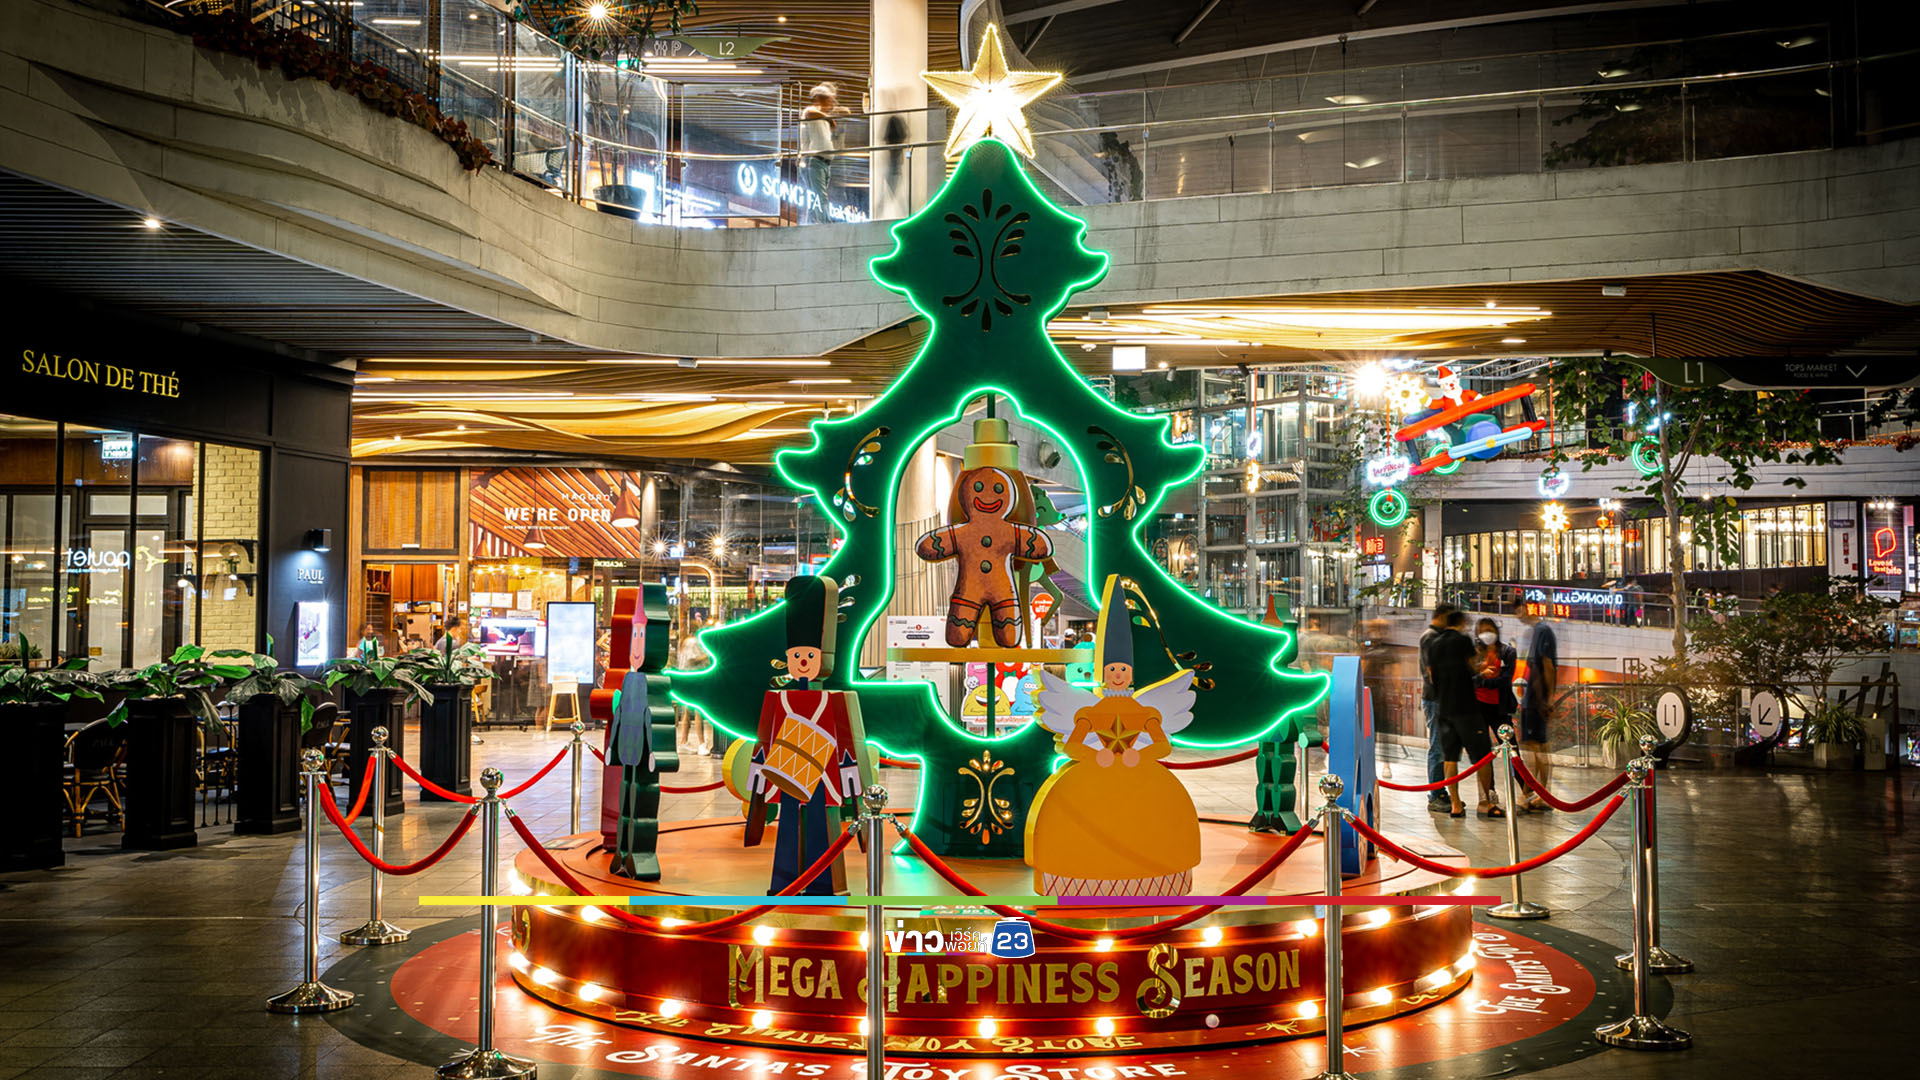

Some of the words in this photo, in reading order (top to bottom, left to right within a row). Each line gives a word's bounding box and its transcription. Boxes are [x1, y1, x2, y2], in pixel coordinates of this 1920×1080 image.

[719, 42, 735, 56] L2
[762, 175, 804, 206] SONG
[22, 350, 100, 384] SALON
[105, 364, 135, 390] DE
[139, 371, 180, 398] THÉ
[1684, 362, 1704, 383] L1
[1785, 364, 1805, 372] TOPS
[1806, 364, 1837, 372] MARKET
[504, 507, 559, 521] WE'RE
[568, 509, 611, 522] OPEN
[1868, 559, 1884, 567] Love
[1886, 566, 1902, 575] bite
[298, 569, 324, 581] PAUL
[1664, 704, 1677, 727] L1
[728, 944, 843, 1009] MEGA
[1136, 943, 1300, 1018] SEASON
[526, 1025, 613, 1049] THE
[605, 1045, 831, 1076] SANTA'S
